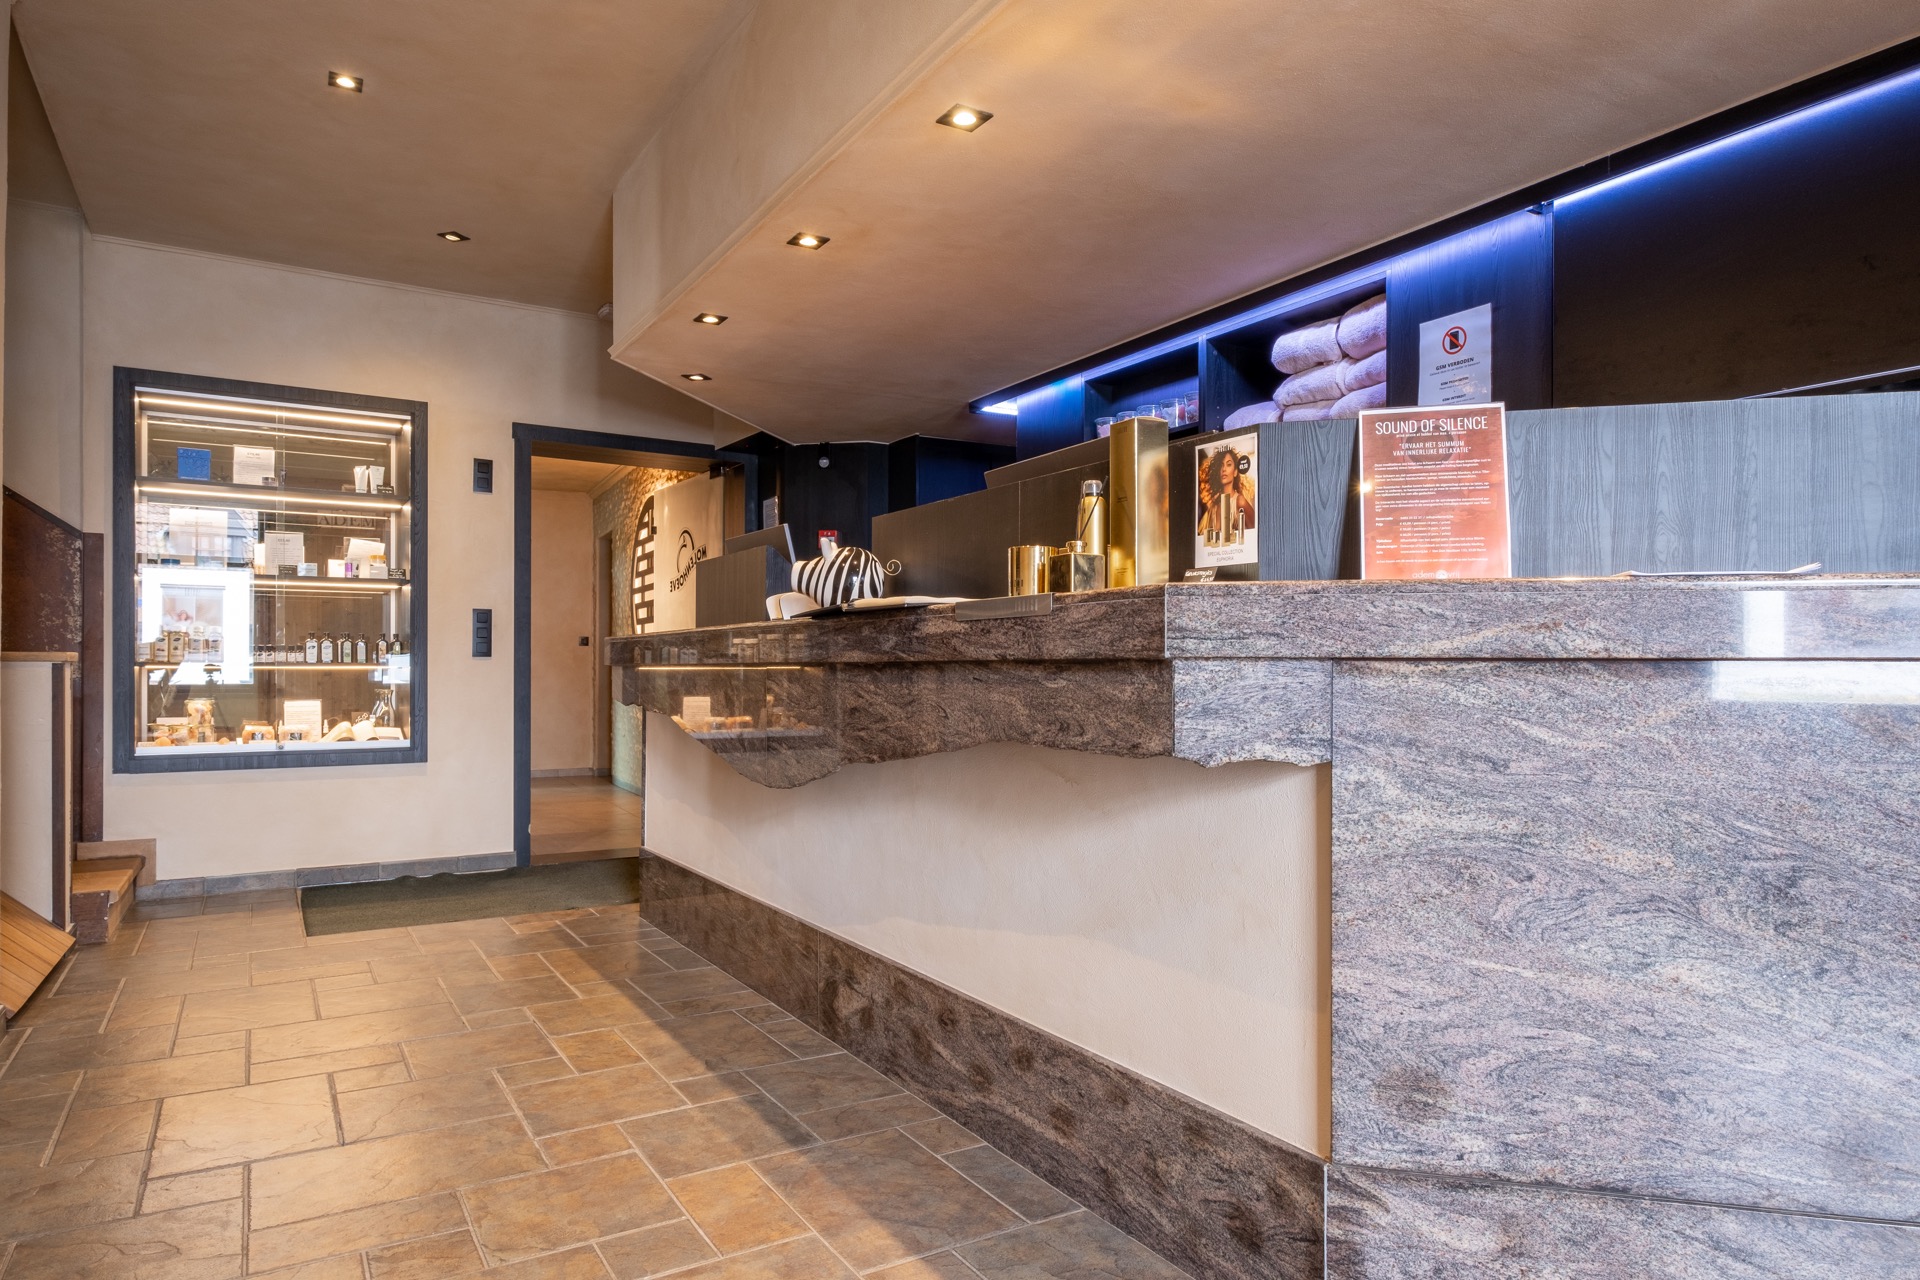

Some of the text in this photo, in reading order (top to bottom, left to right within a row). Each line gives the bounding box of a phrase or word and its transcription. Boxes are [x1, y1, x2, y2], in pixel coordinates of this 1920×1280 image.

[1436, 363, 1446, 371] GSM
[1375, 420, 1418, 435] SOUND
[1421, 419, 1436, 432] OF
[1439, 416, 1488, 431] SILENCE
[1438, 440, 1465, 448] SUMMUM
[1393, 449, 1405, 457] VAN
[1412, 570, 1434, 579] adem
